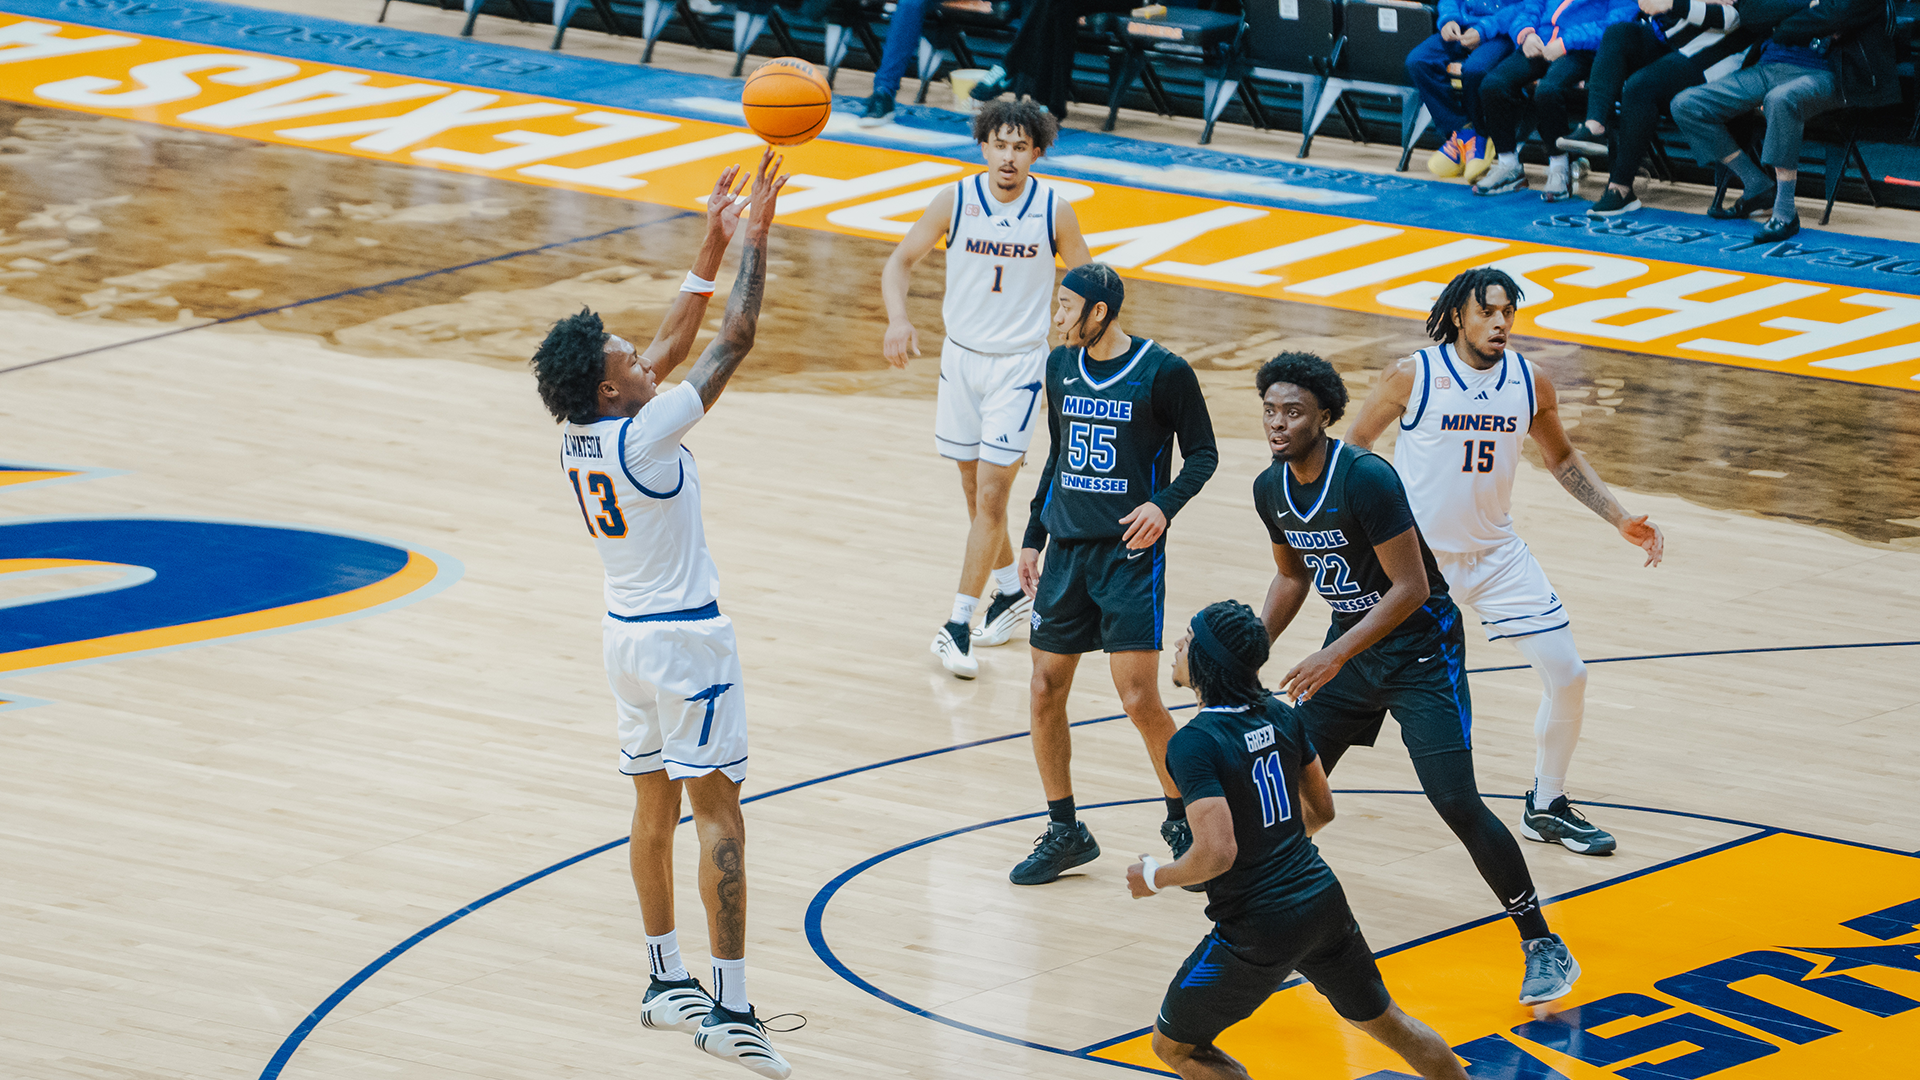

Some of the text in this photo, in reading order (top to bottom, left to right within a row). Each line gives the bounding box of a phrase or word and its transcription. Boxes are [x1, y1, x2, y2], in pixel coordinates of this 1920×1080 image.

[466, 51, 560, 76] EL
[33, 53, 763, 190] TEXAS
[965, 237, 1040, 258] MINERS
[991, 264, 1004, 293] 1
[1062, 395, 1133, 422] MIDDLE
[1440, 414, 1518, 433] MINERS
[1067, 421, 1117, 473] 55
[1461, 439, 1496, 474] 15
[1061, 471, 1128, 495] TENNESSEE
[568, 467, 629, 539] 13
[1284, 529, 1349, 550] MIDDLE
[1303, 552, 1362, 596] 22
[1326, 590, 1383, 613] NNESSEE
[1244, 723, 1276, 754] GREEN
[1251, 750, 1292, 828] 11
